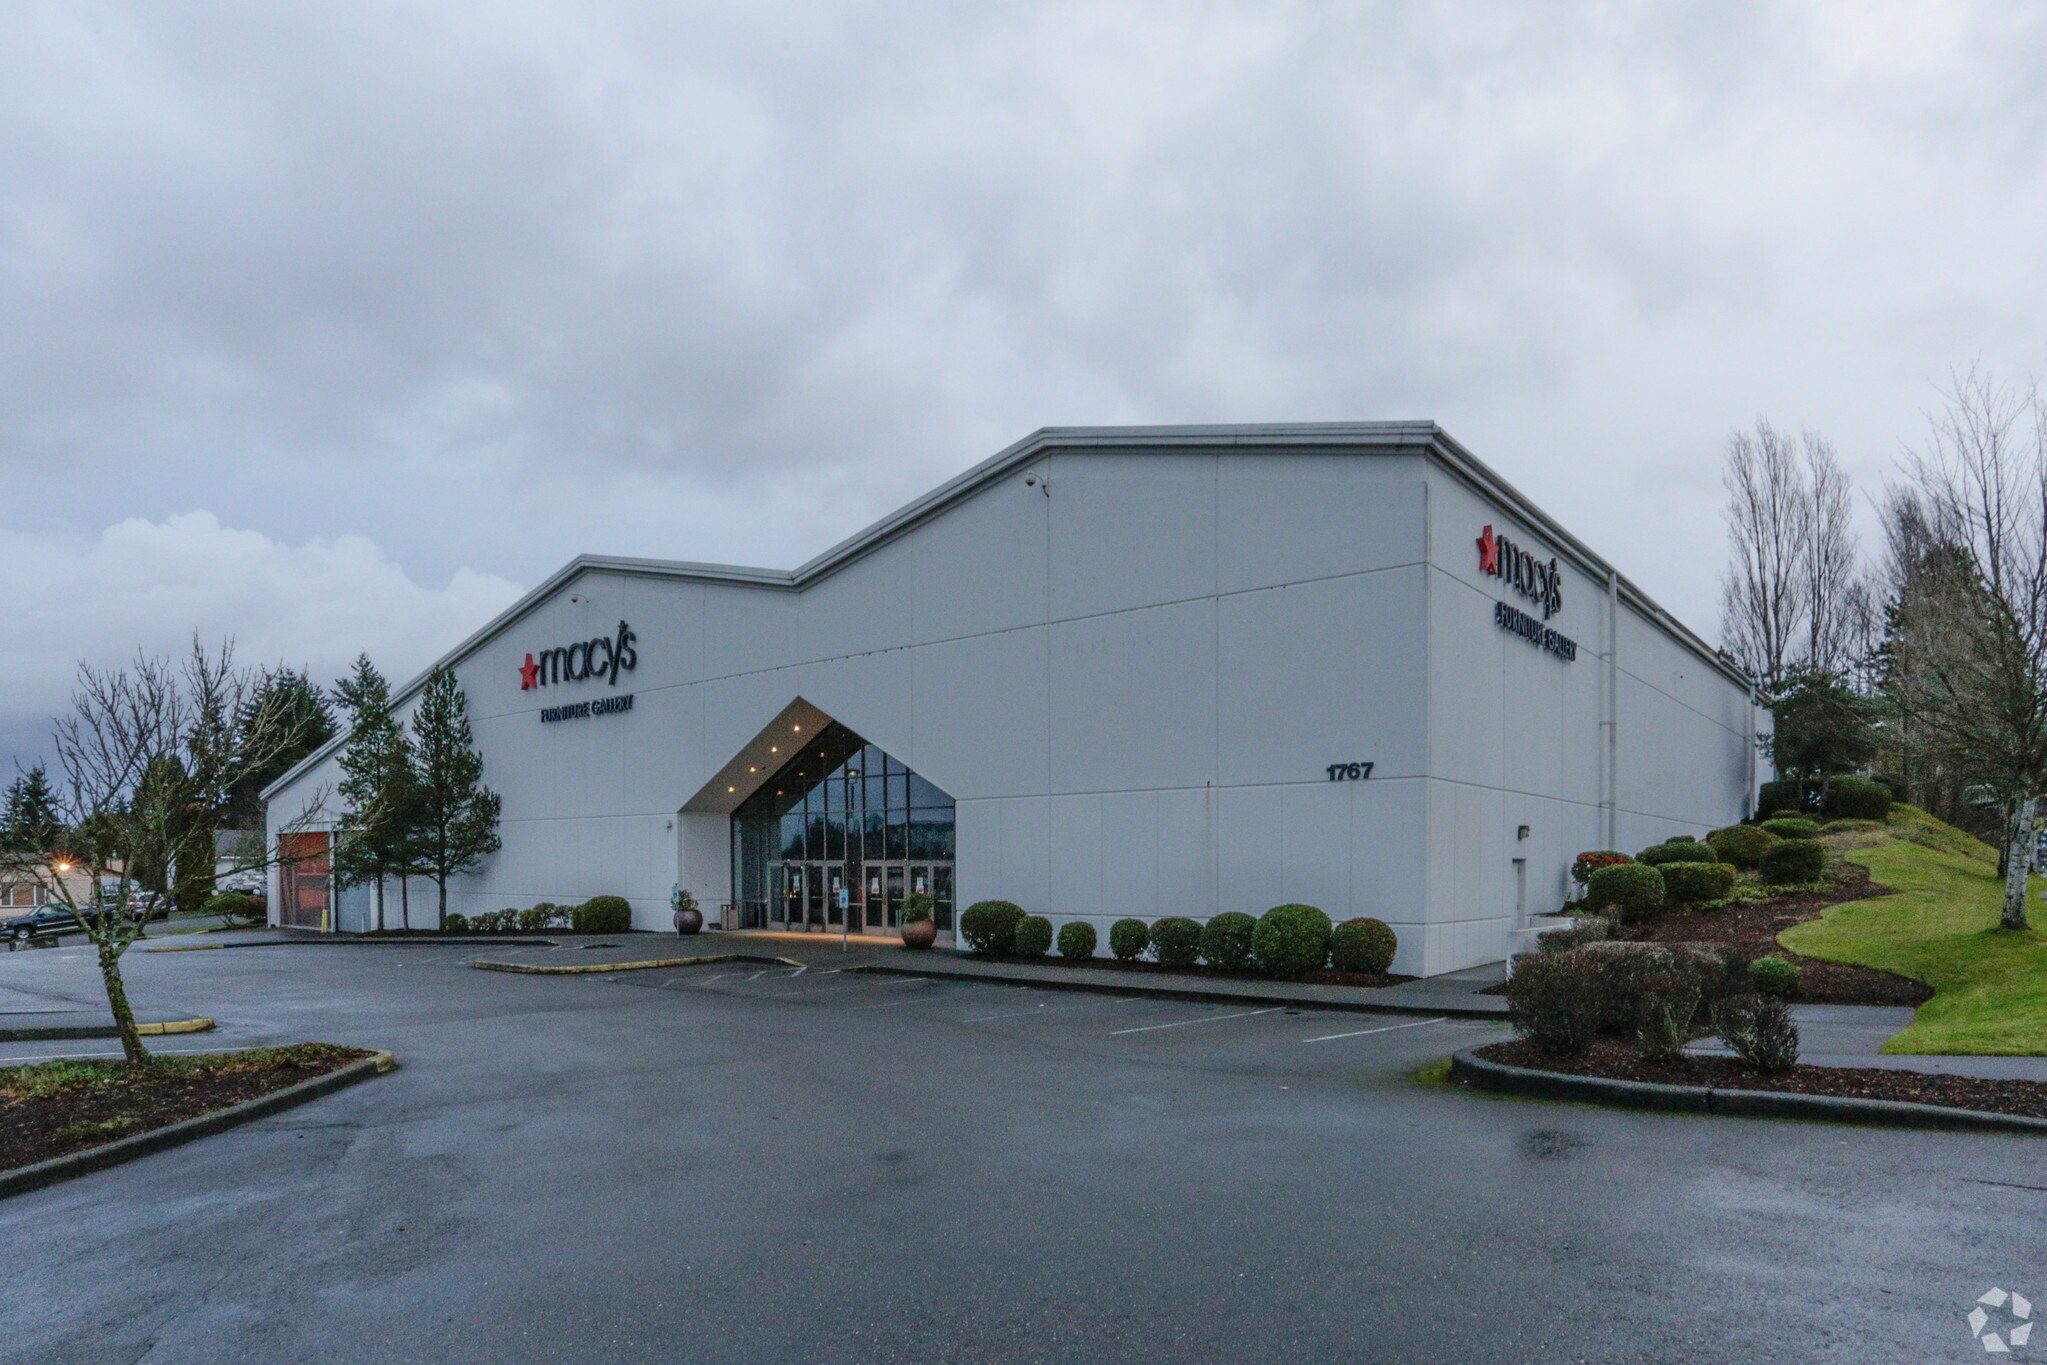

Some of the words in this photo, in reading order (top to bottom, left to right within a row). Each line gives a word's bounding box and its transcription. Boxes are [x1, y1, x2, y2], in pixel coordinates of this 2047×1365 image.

[1496, 534, 1562, 620] macy's
[539, 619, 637, 686] macy's
[541, 701, 591, 723] FURNITURE
[591, 694, 634, 716] GALLERY
[1326, 762, 1374, 781] 1767
